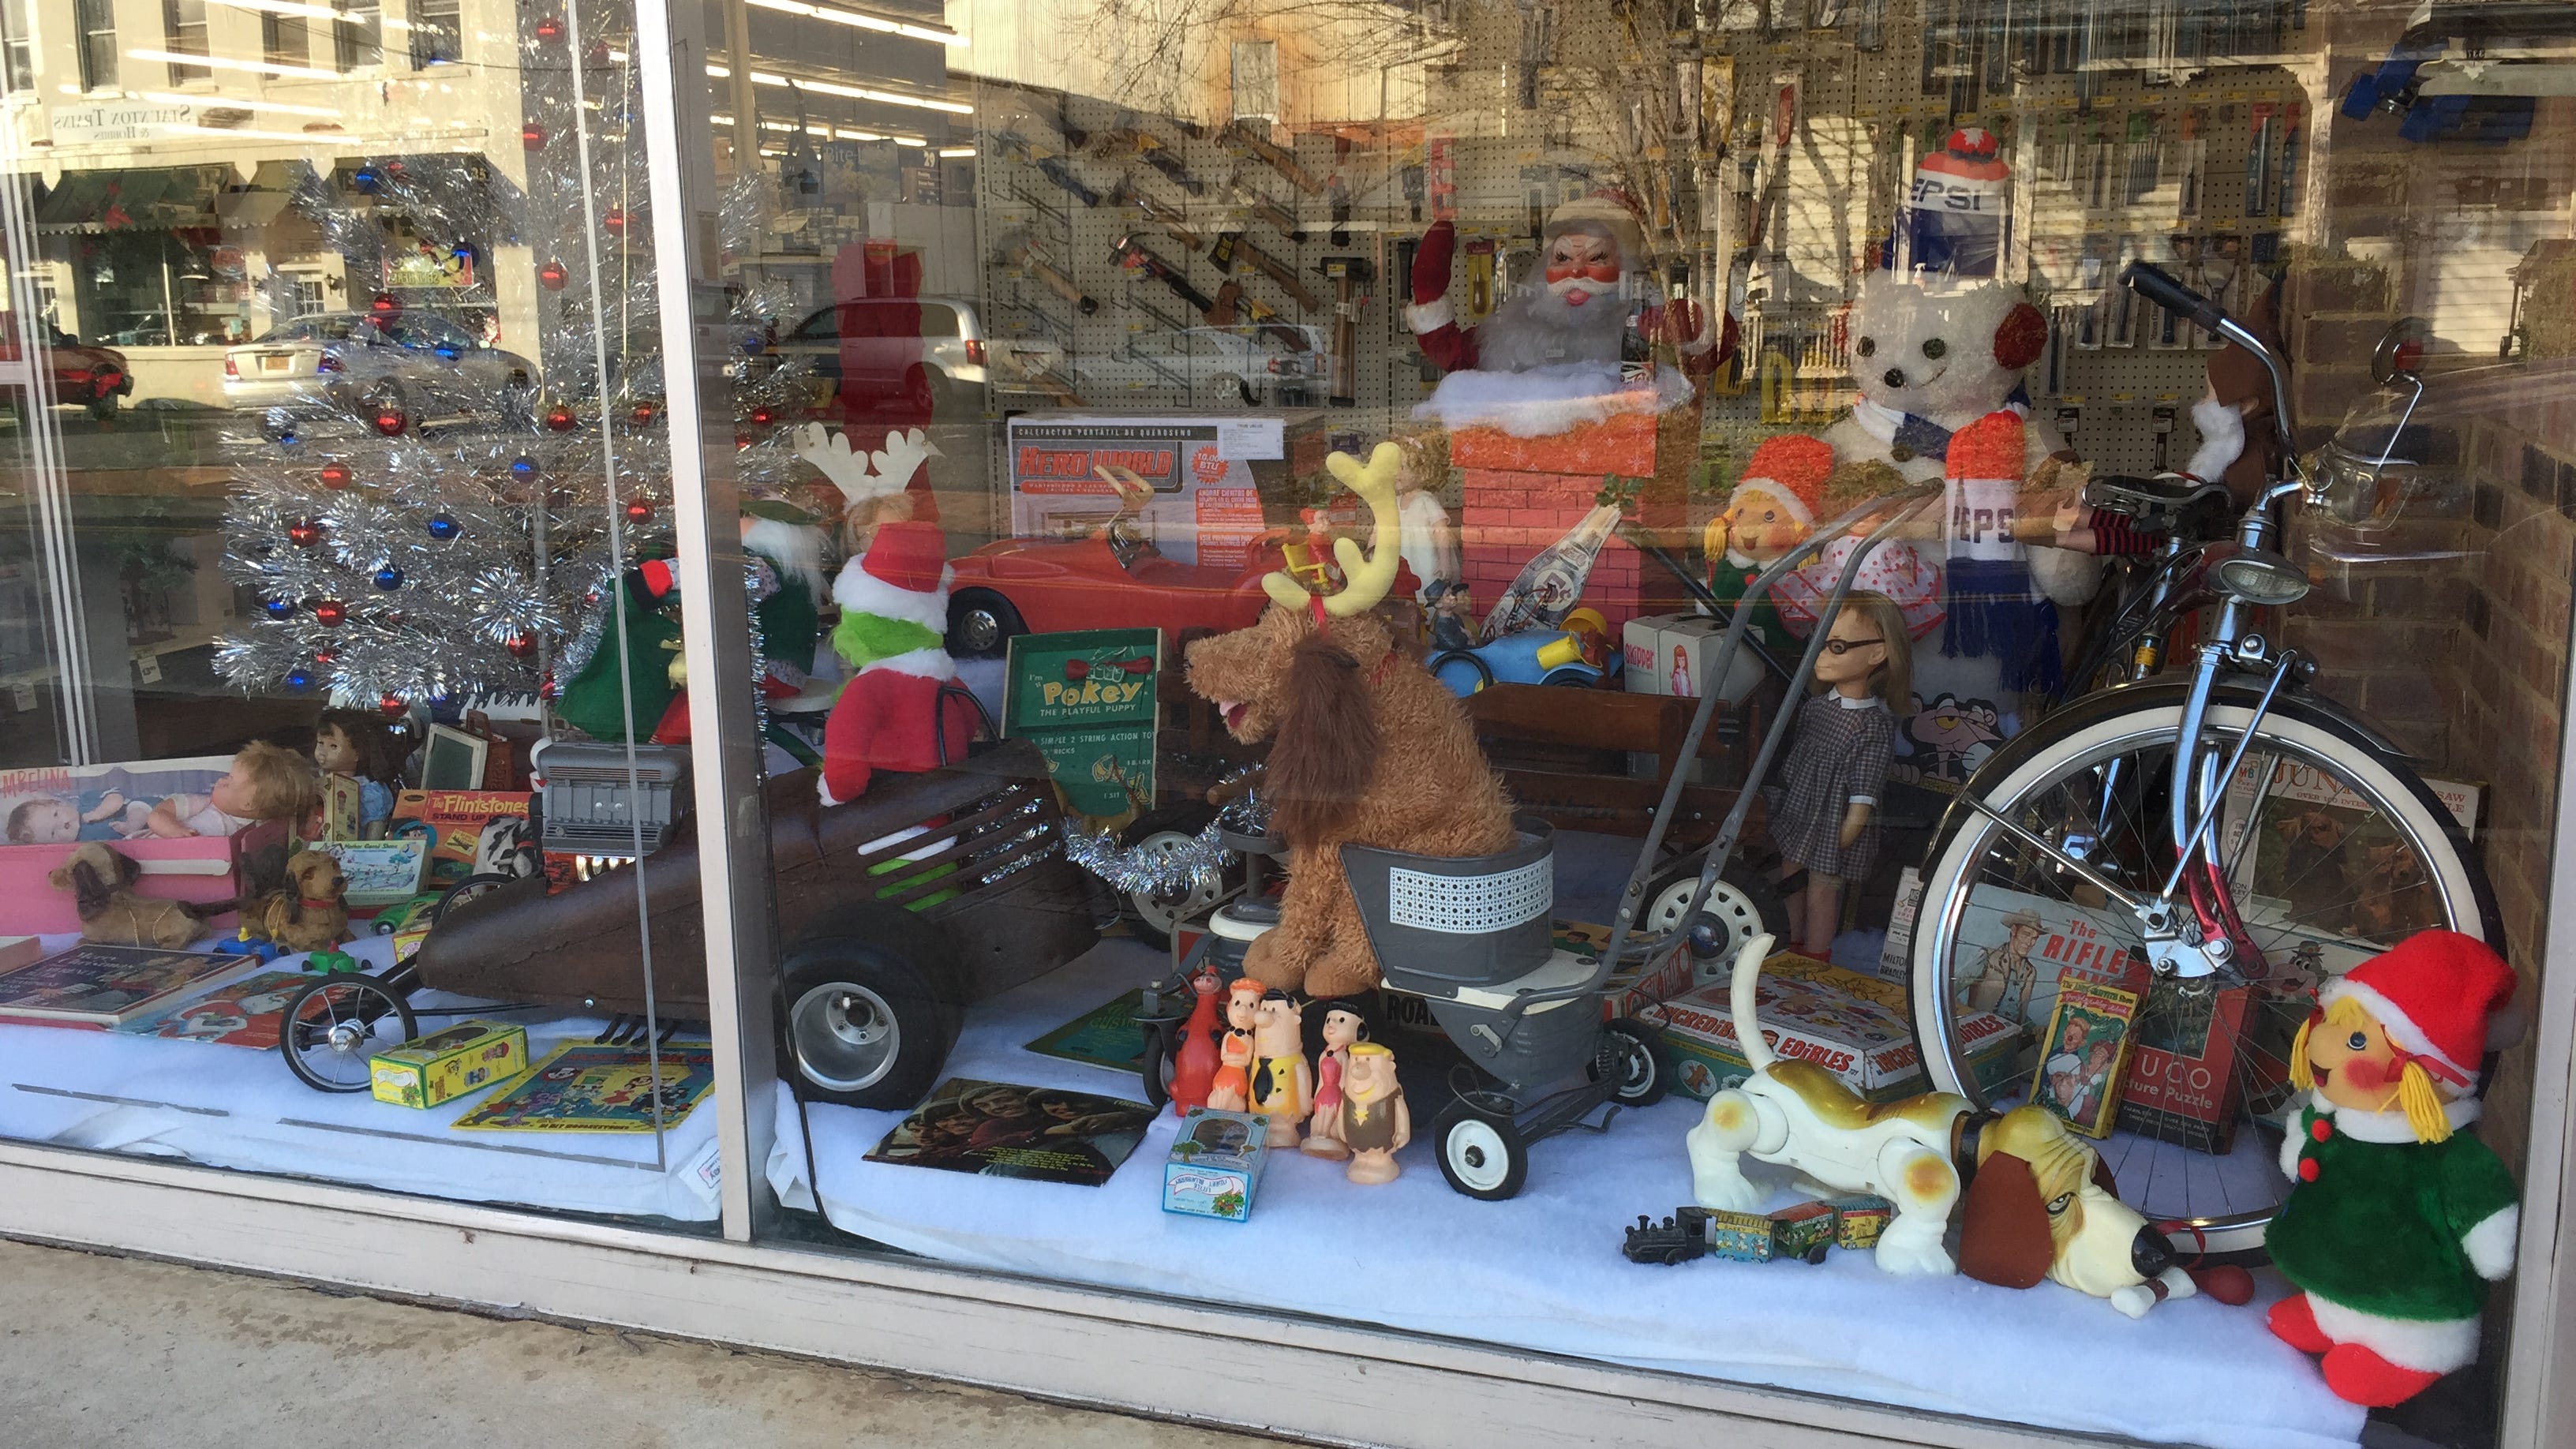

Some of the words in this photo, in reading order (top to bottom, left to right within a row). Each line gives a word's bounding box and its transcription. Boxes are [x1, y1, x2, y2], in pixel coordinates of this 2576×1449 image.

[923, 150, 936, 168] 29
[1911, 178, 1981, 211] EPSI
[1077, 426, 1119, 436] PORTÁTIL
[1017, 445, 1090, 478] KERO
[1091, 449, 1174, 479] WORLD
[1200, 461, 1219, 470] BTU
[1953, 505, 2015, 544] EPS
[1625, 643, 1655, 670] Skipper
[1061, 706, 1101, 716] PLAYFUL
[1106, 704, 1136, 713] PUPPY
[1041, 736, 1066, 746] SIMPLE
[1080, 734, 1106, 743] STRING
[1110, 732, 1138, 741] ACTION
[2238, 766, 2255, 779] MB
[444, 795, 529, 814] Flintstones
[2297, 792, 2320, 802] OVER
[2436, 791, 2466, 803] SAW
[1883, 953, 1907, 966] MILTO
[2042, 934, 2127, 975] RIFLE
[2142, 1054, 2211, 1090] UCO
[2125, 1079, 2159, 1095] ture
[2165, 1087, 2213, 1109] Puzzle
